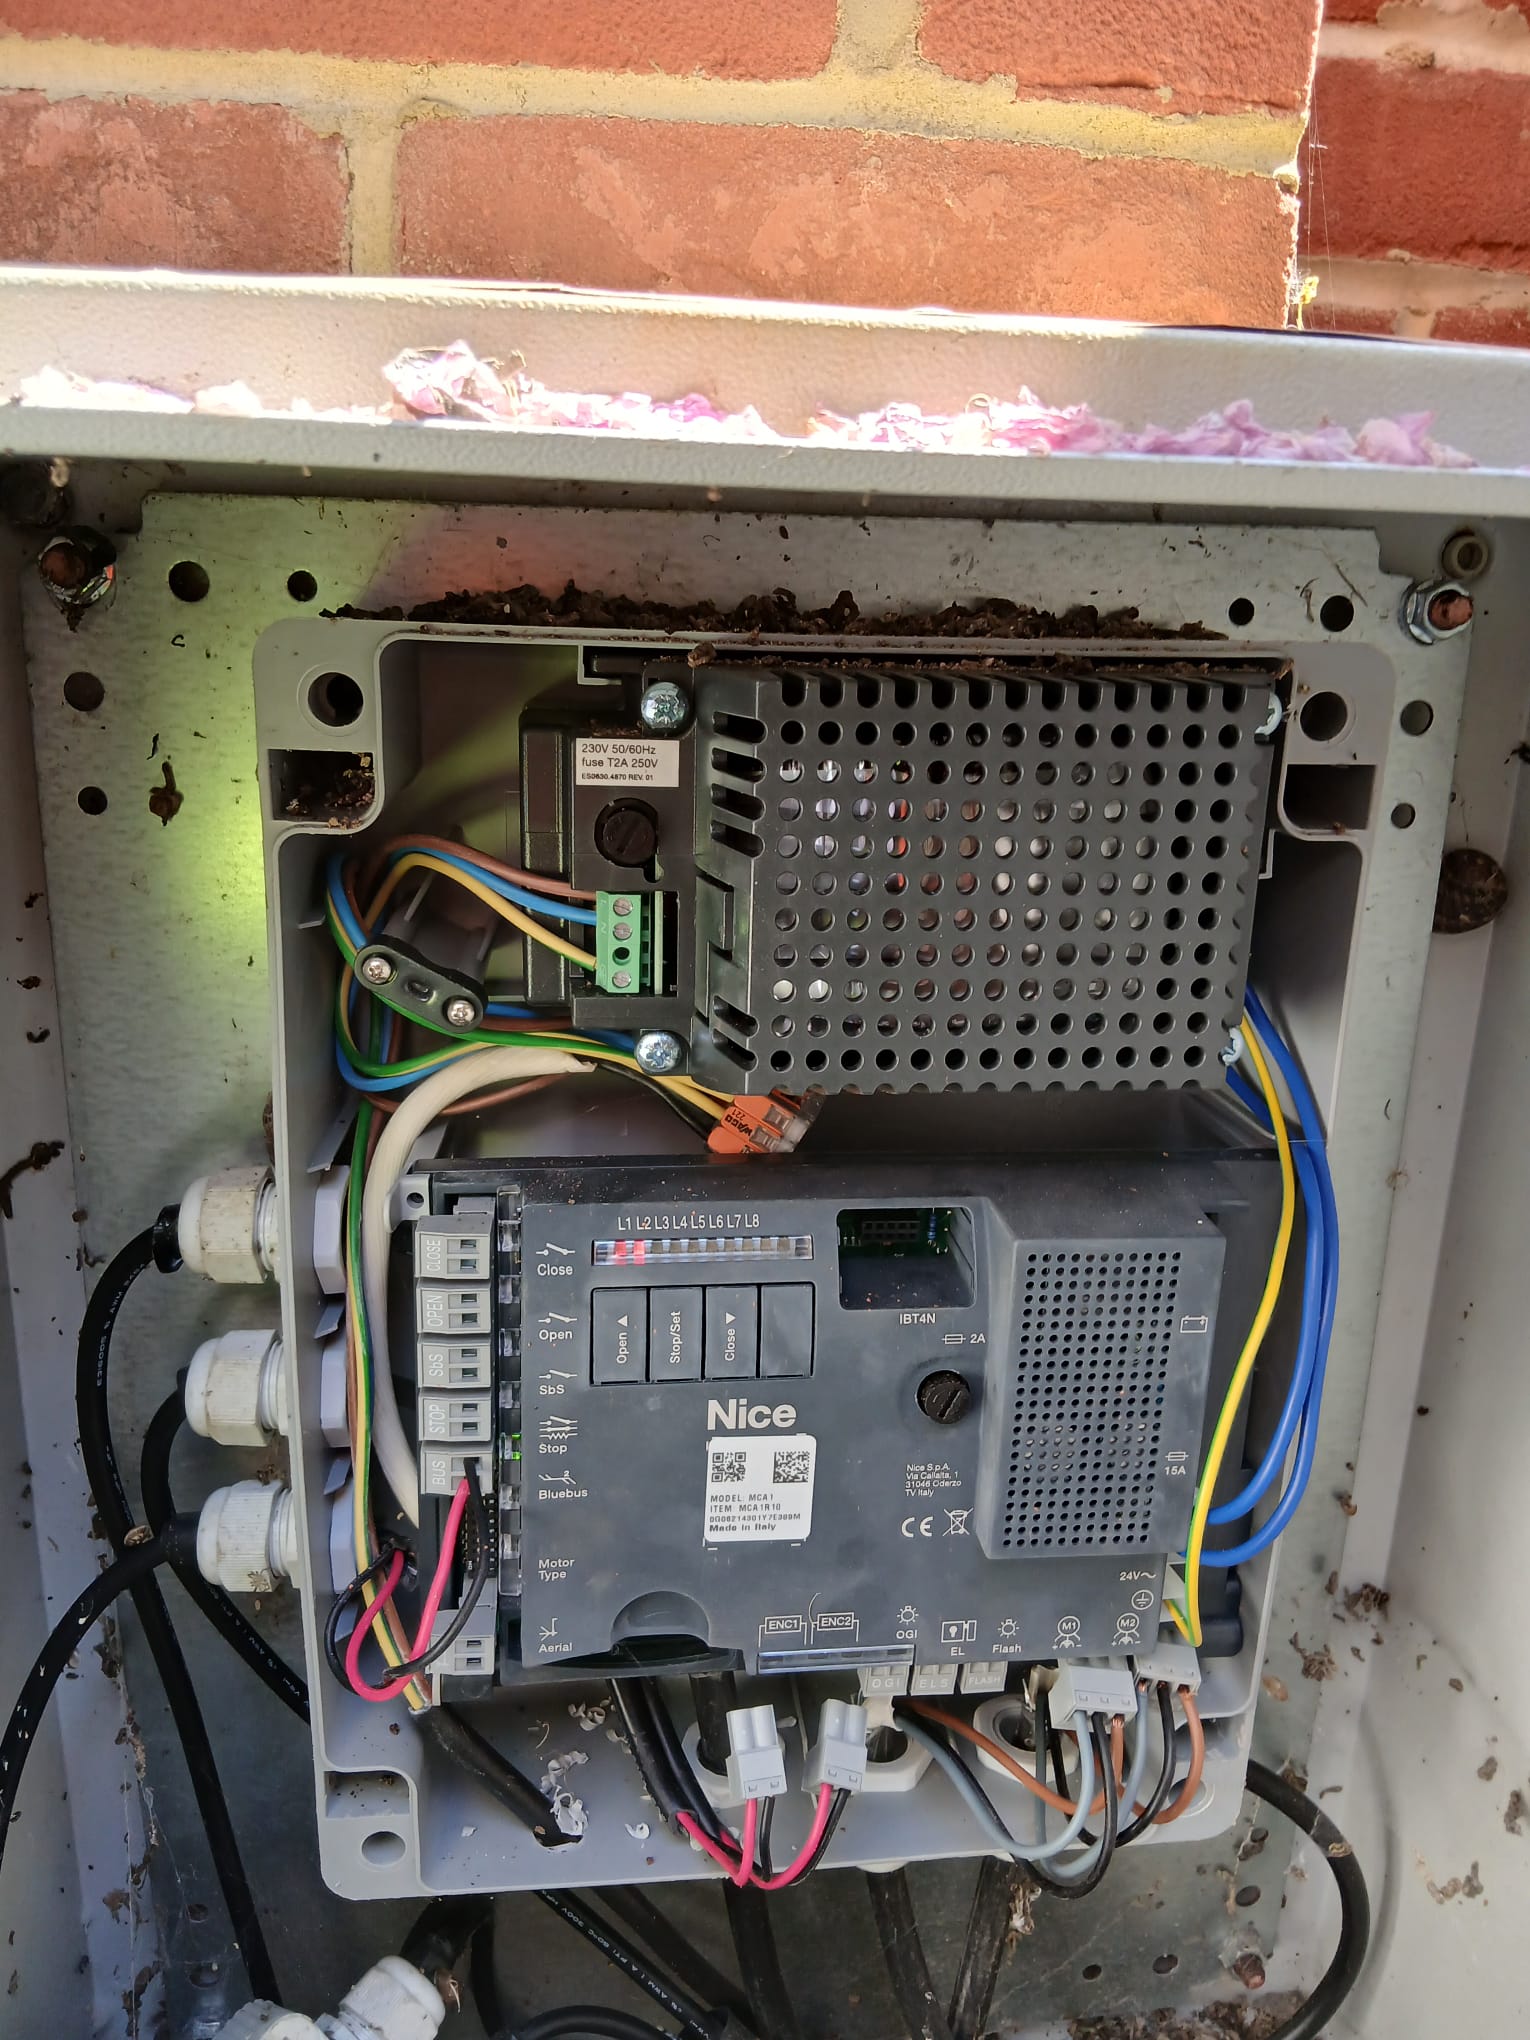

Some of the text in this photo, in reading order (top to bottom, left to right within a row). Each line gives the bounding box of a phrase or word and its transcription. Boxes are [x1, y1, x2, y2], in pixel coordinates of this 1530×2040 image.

[582, 744, 656, 754] 230V 50/60Hz
[582, 757, 658, 768] fuse T2A 250V
[731, 1108, 746, 1120] 221
[724, 1114, 753, 1136] WAGO
[618, 1214, 760, 1231] L1 L2 L3 L4 L5 L6 L7 L8
[426, 1238, 441, 1272] CLOSE
[537, 1264, 573, 1276] Close
[427, 1294, 444, 1327] OPEN
[899, 1312, 936, 1324] IBT4N
[538, 1328, 573, 1342] Open
[670, 1310, 682, 1364] Stop/Set
[970, 1333, 986, 1344] 2A
[616, 1332, 628, 1364] Open
[725, 1328, 736, 1362] Close
[428, 1354, 444, 1377] SbS
[538, 1384, 566, 1396] SbS
[428, 1404, 446, 1434] STOP
[707, 1398, 797, 1431] Nice
[538, 1444, 568, 1455] Stop
[432, 1460, 446, 1486] BUS
[906, 1464, 925, 1472] Nice
[1164, 1464, 1186, 1476] 15A
[906, 1472, 918, 1480] Via
[538, 1488, 588, 1500] Bluebus
[904, 1488, 934, 1498] TV Italy
[710, 1524, 737, 1532] Made
[754, 1523, 777, 1532] Italy
[901, 1516, 934, 1538] CE
[538, 1558, 575, 1568] Motor
[538, 1570, 567, 1582] Type
[768, 1616, 852, 1630] ENC1 ENC2
[1062, 1622, 1077, 1630] M1
[1120, 1618, 1136, 1628] M2
[896, 1630, 918, 1640] OGI
[538, 1642, 572, 1654] Aerial
[950, 1646, 965, 1656] EL
[992, 1644, 1022, 1654] Flash
[561, 1907, 584, 1928] 300V
